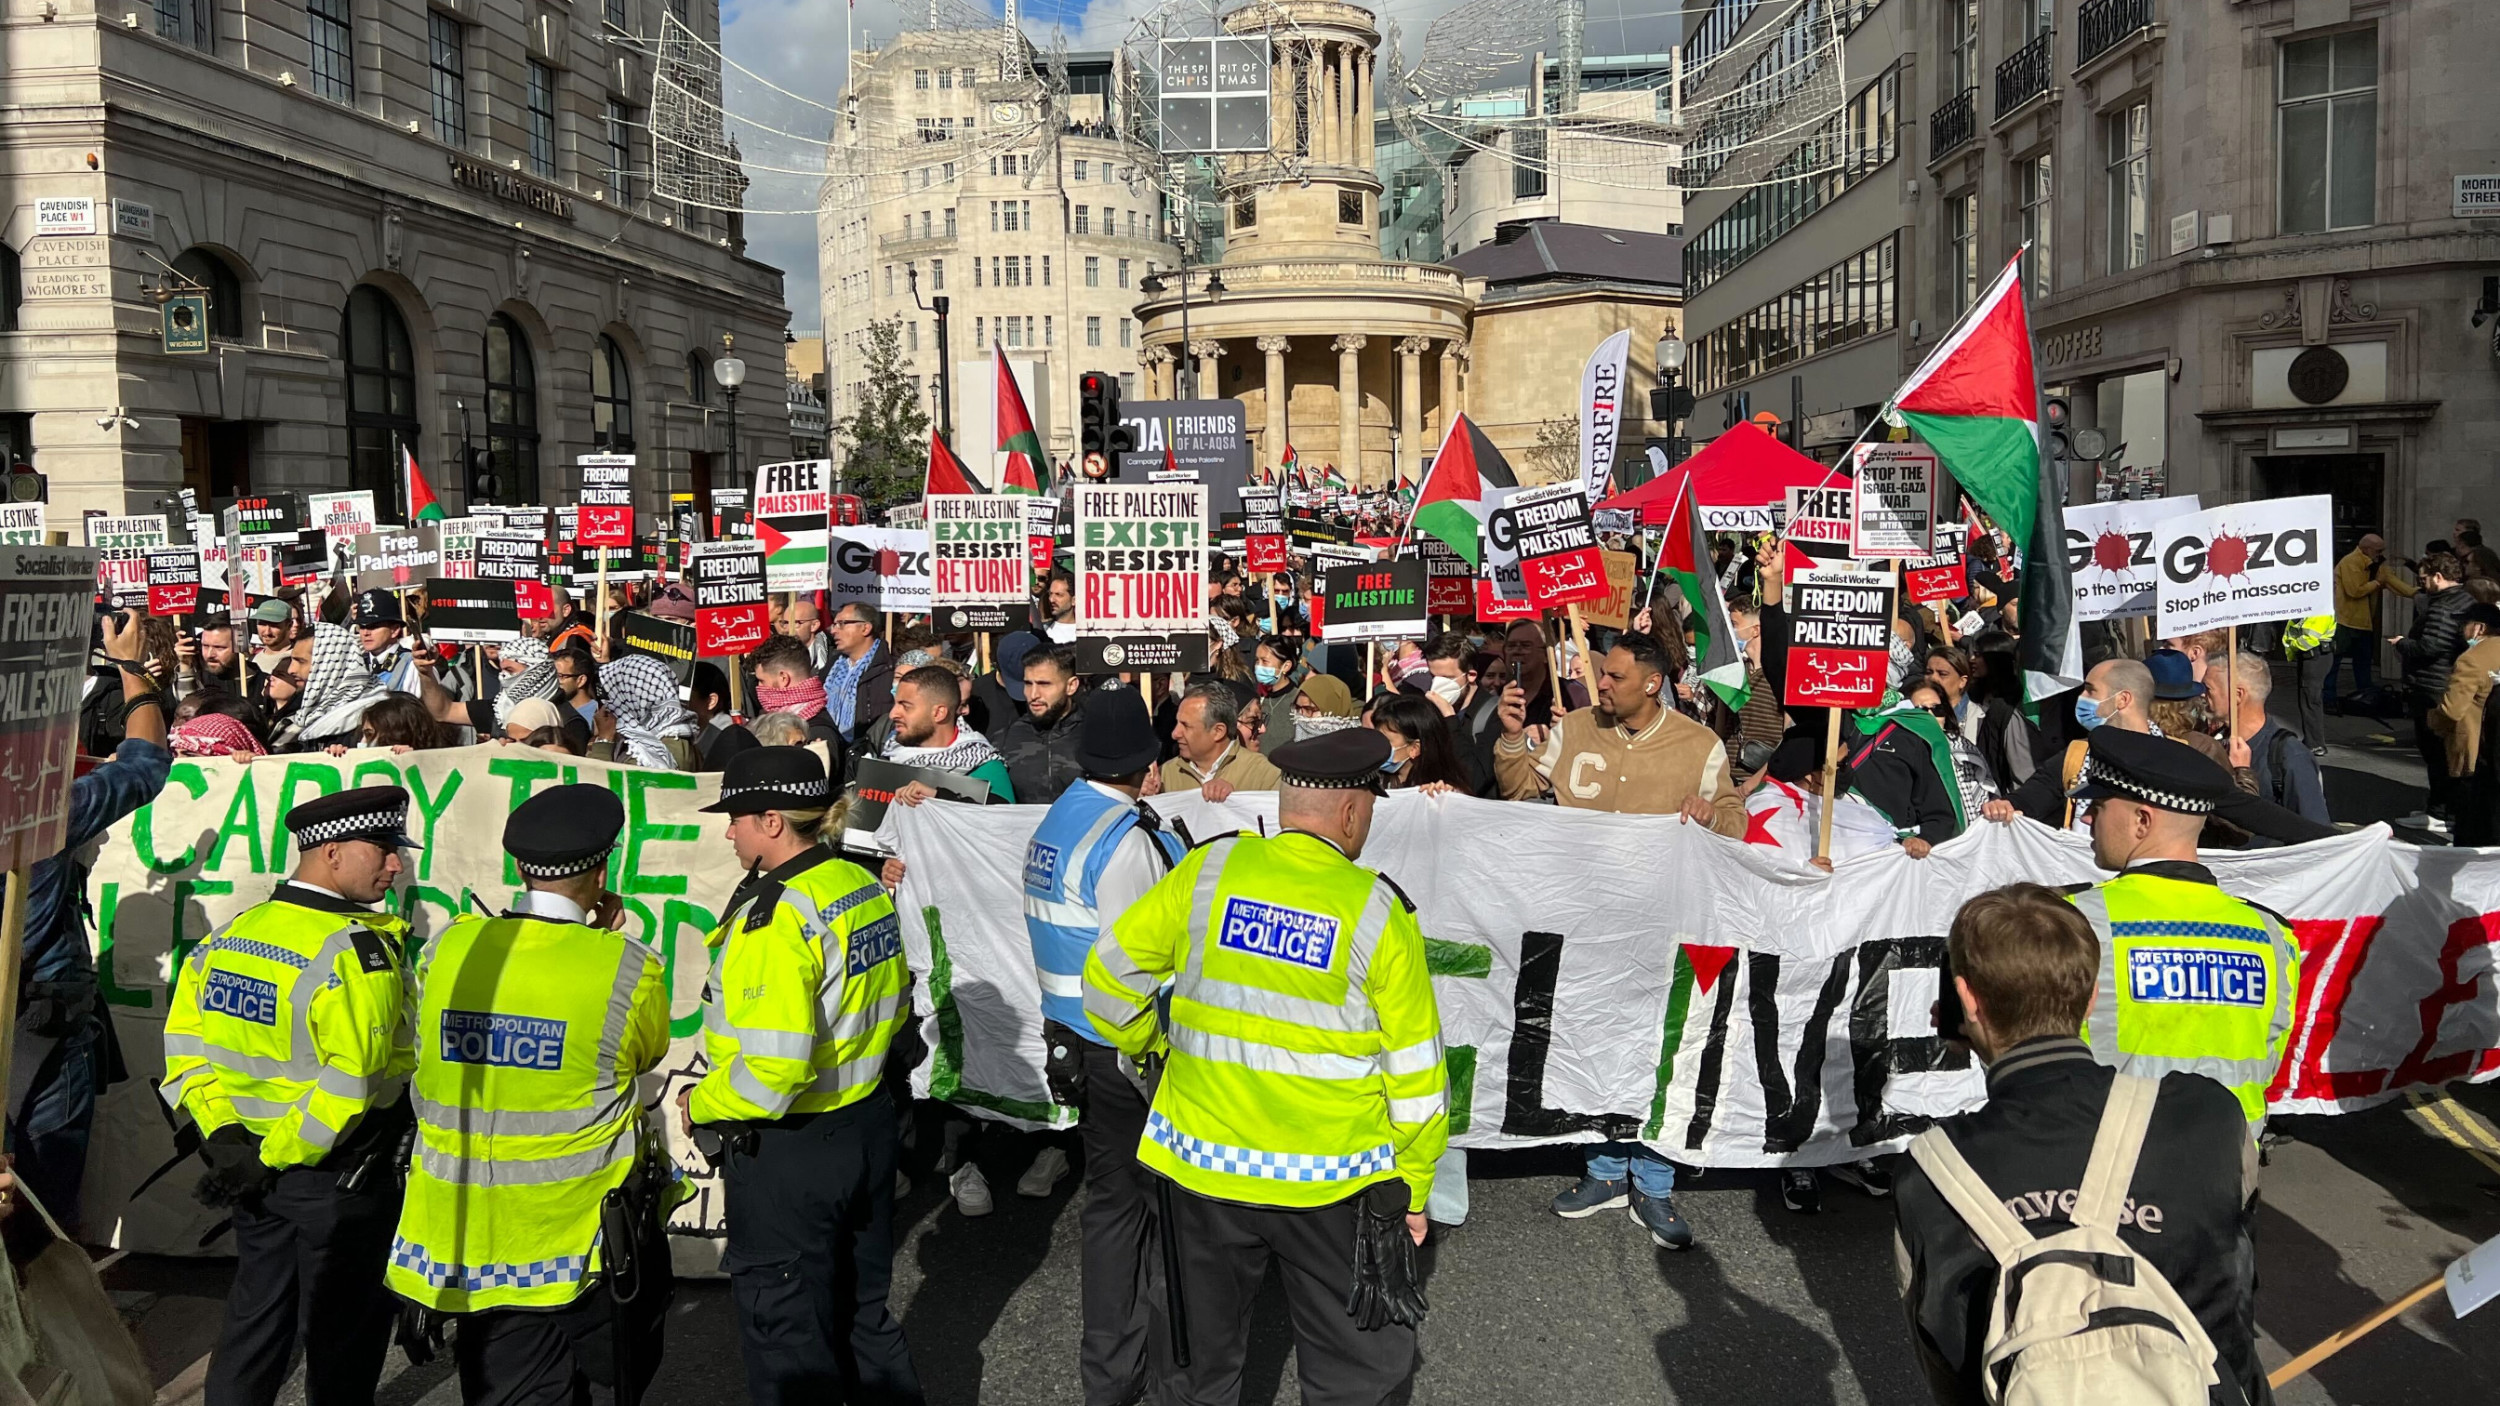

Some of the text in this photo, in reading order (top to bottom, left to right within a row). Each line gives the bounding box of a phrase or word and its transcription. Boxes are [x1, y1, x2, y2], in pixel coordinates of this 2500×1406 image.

[1167, 65, 1188, 74] THE
[1242, 63, 1258, 73] OF
[2461, 178, 2500, 190] MORTI
[40, 201, 88, 211] CAVENDISH
[118, 202, 150, 218] LANGHAM
[41, 212, 84, 222] PLACE W1
[119, 215, 140, 227] PLACE
[32, 240, 105, 253] CAVENDISH
[38, 255, 79, 266] PLACE
[37, 273, 96, 283] LEADING TO
[27, 284, 87, 296] WIGMORE
[169, 340, 203, 348] WIGMORE
[2046, 325, 2102, 367] COFFEE
[1176, 415, 1236, 435] FRIENDS
[1177, 436, 1237, 451] OF AL-AQSA
[1871, 449, 1913, 457] Socialist
[583, 468, 629, 483] FREEDOM
[766, 463, 819, 493] FREE
[1863, 466, 1923, 481] STOP THE
[1515, 486, 1572, 504] Socialist Worker
[1863, 482, 1926, 494] ISRAEL-GAZA
[236, 498, 268, 510] STOP
[580, 489, 631, 505] PALESTINE
[715, 496, 744, 504] FREEDOM
[757, 492, 827, 515] PALESTINE
[1084, 492, 1199, 518] FREE PALESTINE
[1797, 488, 1852, 520] FREE
[1879, 495, 1911, 509] WAR
[332, 501, 352, 513] END
[934, 500, 960, 519] FREE
[964, 500, 1020, 519] PALESTINE
[1245, 498, 1279, 513] FREEDOM
[1514, 498, 1582, 529] FREEDOM
[324, 511, 362, 525] ISRAELI
[509, 515, 544, 526] FREEDOM
[588, 510, 621, 525] الحرية
[1863, 512, 1926, 521] FOR A SOCIALIST
[94, 518, 162, 534] FREE PALESTINE
[240, 520, 271, 532] GAZA
[444, 522, 461, 535] FREE
[583, 523, 625, 539] لفلسطين
[935, 521, 1022, 541] EXIST!
[1246, 519, 1283, 534] PALESTINE
[1545, 523, 1558, 533] for
[1787, 519, 1852, 541] PALESTIN
[1879, 521, 1913, 530] INTIFADA
[95, 533, 164, 549] EXIST!
[1084, 522, 1199, 548] EXIST!
[1519, 526, 1593, 557] PALESTINE
[379, 535, 419, 552] Free
[481, 540, 537, 557] FREEDOM
[703, 544, 755, 554] Socialist Worker
[936, 542, 1022, 558] RESIST!
[1253, 538, 1280, 553] الحرية
[1252, 552, 1284, 566] لفلسطين
[1320, 546, 1361, 558] Socialist Worker
[15, 554, 66, 576] Socialist
[151, 555, 195, 568] FREEDOM
[359, 550, 438, 572] Palestine
[700, 556, 760, 578] FREEDOM
[1084, 550, 1199, 571] RESIST!
[1538, 554, 1586, 579] الحرية
[1905, 551, 1959, 570] PALESTINE
[150, 571, 199, 585] PALESTINE
[478, 561, 539, 579] PALESTINE
[936, 559, 1022, 594] RETURN!
[1495, 565, 1520, 583] End
[1917, 569, 1952, 584] الحرية
[726, 576, 737, 585] for
[1356, 573, 1392, 591] FREE
[1538, 572, 1598, 599] لفلسطين
[1808, 572, 1881, 585] Socialist Worker
[159, 587, 192, 600] الحرية
[698, 582, 765, 605] PALESTINE
[837, 583, 885, 596] Stop the
[1084, 572, 1199, 619] RETURN!
[1429, 581, 1461, 595] الحرية
[1916, 580, 1960, 597] لفلسطين
[2091, 582, 2116, 597] the
[156, 597, 197, 611] لفلسطين
[431, 598, 515, 610] #STOPARMINGISRAEL
[1335, 589, 1415, 609] PALESTINE
[1801, 589, 1883, 614] FREEDOM
[2165, 596, 2200, 615] Stop
[2203, 590, 2227, 605] the
[2231, 579, 2321, 600] massacre
[2, 591, 94, 643] FREEDOM
[710, 609, 755, 629] الحرية
[1834, 611, 1849, 622] for
[2209, 614, 2239, 624] Coalition
[2242, 606, 2313, 619] www.stopwar.org.uk
[707, 626, 761, 648] لفلسطين
[1794, 620, 1885, 647] PALESTINE
[1127, 643, 1177, 651] PALESTINE
[1127, 650, 1182, 658] SOLIDARITY
[1127, 657, 1176, 665] CAMPAIGN
[1807, 653, 1868, 674] الحرية
[1798, 673, 1874, 695] لفلسطين
[1569, 751, 1607, 799] C
[1232, 902, 1329, 935] METROPOLITAN
[1225, 917, 1326, 964] POLICE
[2134, 951, 2263, 969] METROPOLITAN
[207, 969, 278, 998] METROPOLITAN
[2135, 966, 2264, 1001] POLICE
[203, 985, 276, 1023] POLICE
[442, 1012, 564, 1039] METROPOLITAN
[441, 1030, 559, 1067] POLICE
[2003, 1188, 2164, 1234] nvese
